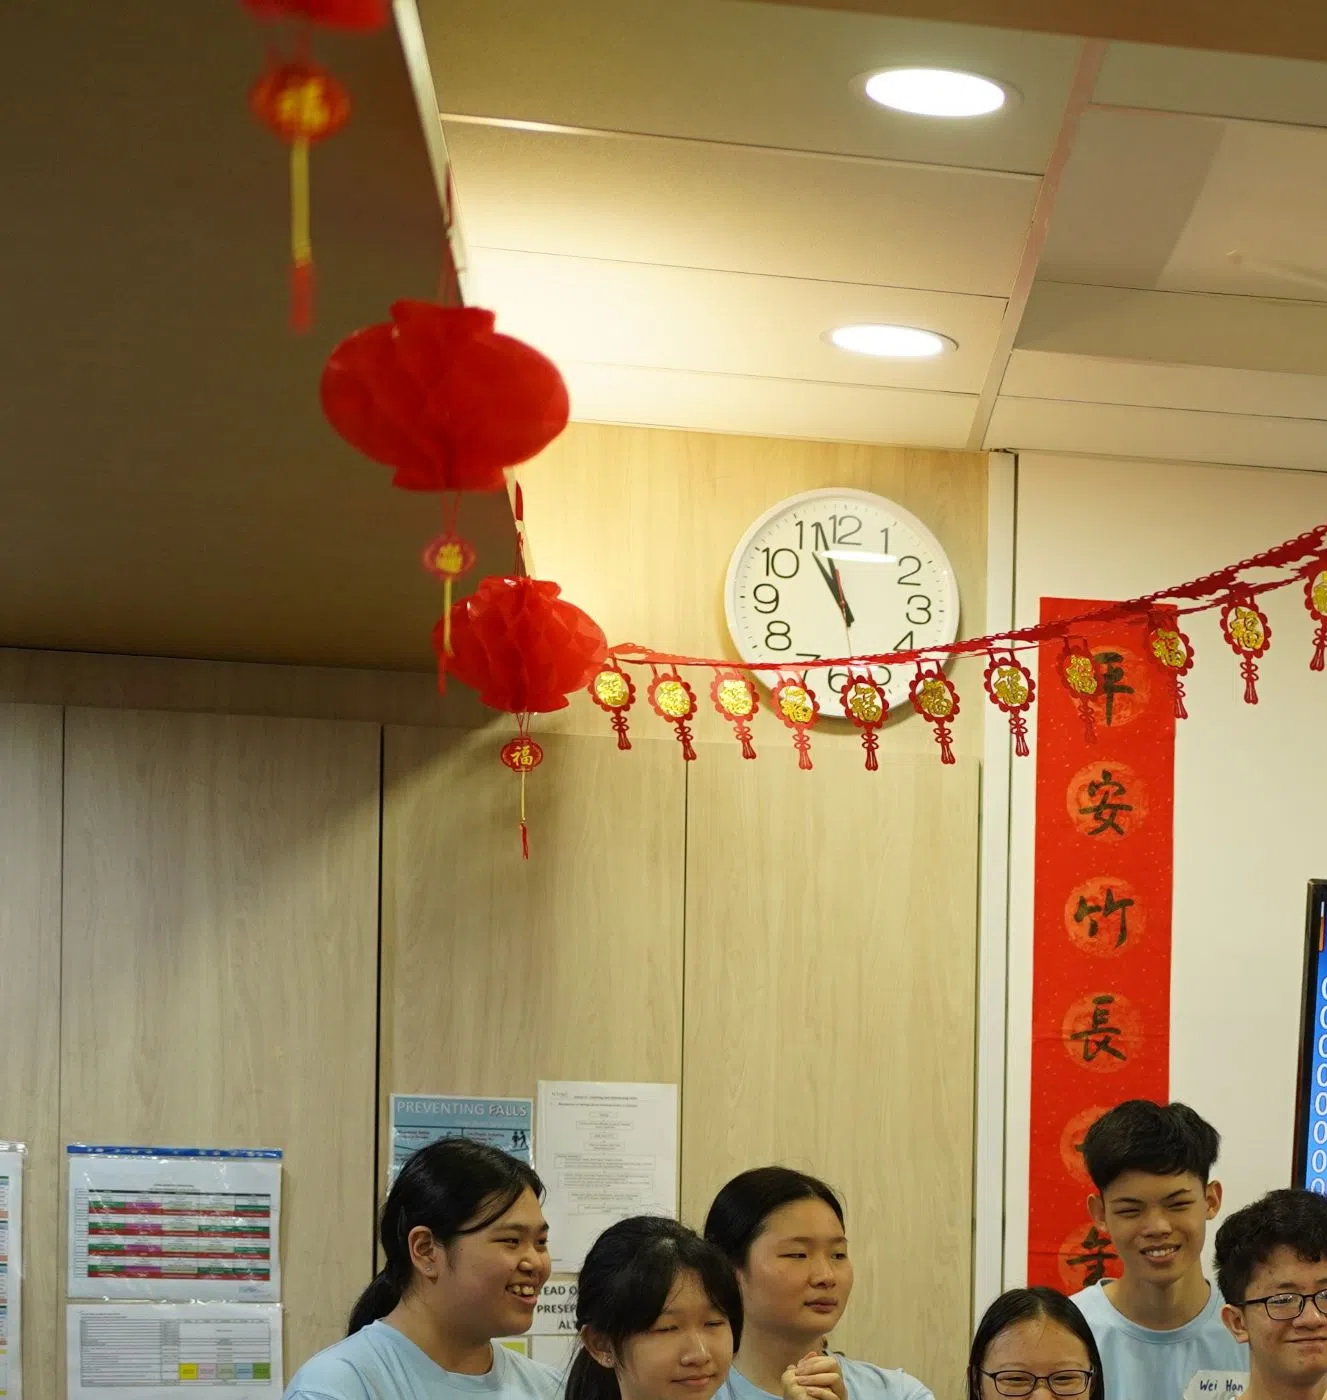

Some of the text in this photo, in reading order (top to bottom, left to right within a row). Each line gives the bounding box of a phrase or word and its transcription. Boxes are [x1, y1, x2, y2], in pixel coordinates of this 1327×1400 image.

[795, 520, 820, 551] 11
[829, 515, 862, 546] 12
[880, 527, 889, 555] 1
[761, 547, 800, 579] 10
[897, 556, 922, 586] 2
[753, 583, 780, 614] 9
[906, 595, 932, 625] 3
[765, 620, 792, 651] 8
[510, 745, 534, 766] 福
[396, 1101, 528, 1117] PREVENTING FALLS
[543, 1286, 566, 1296] EAD
